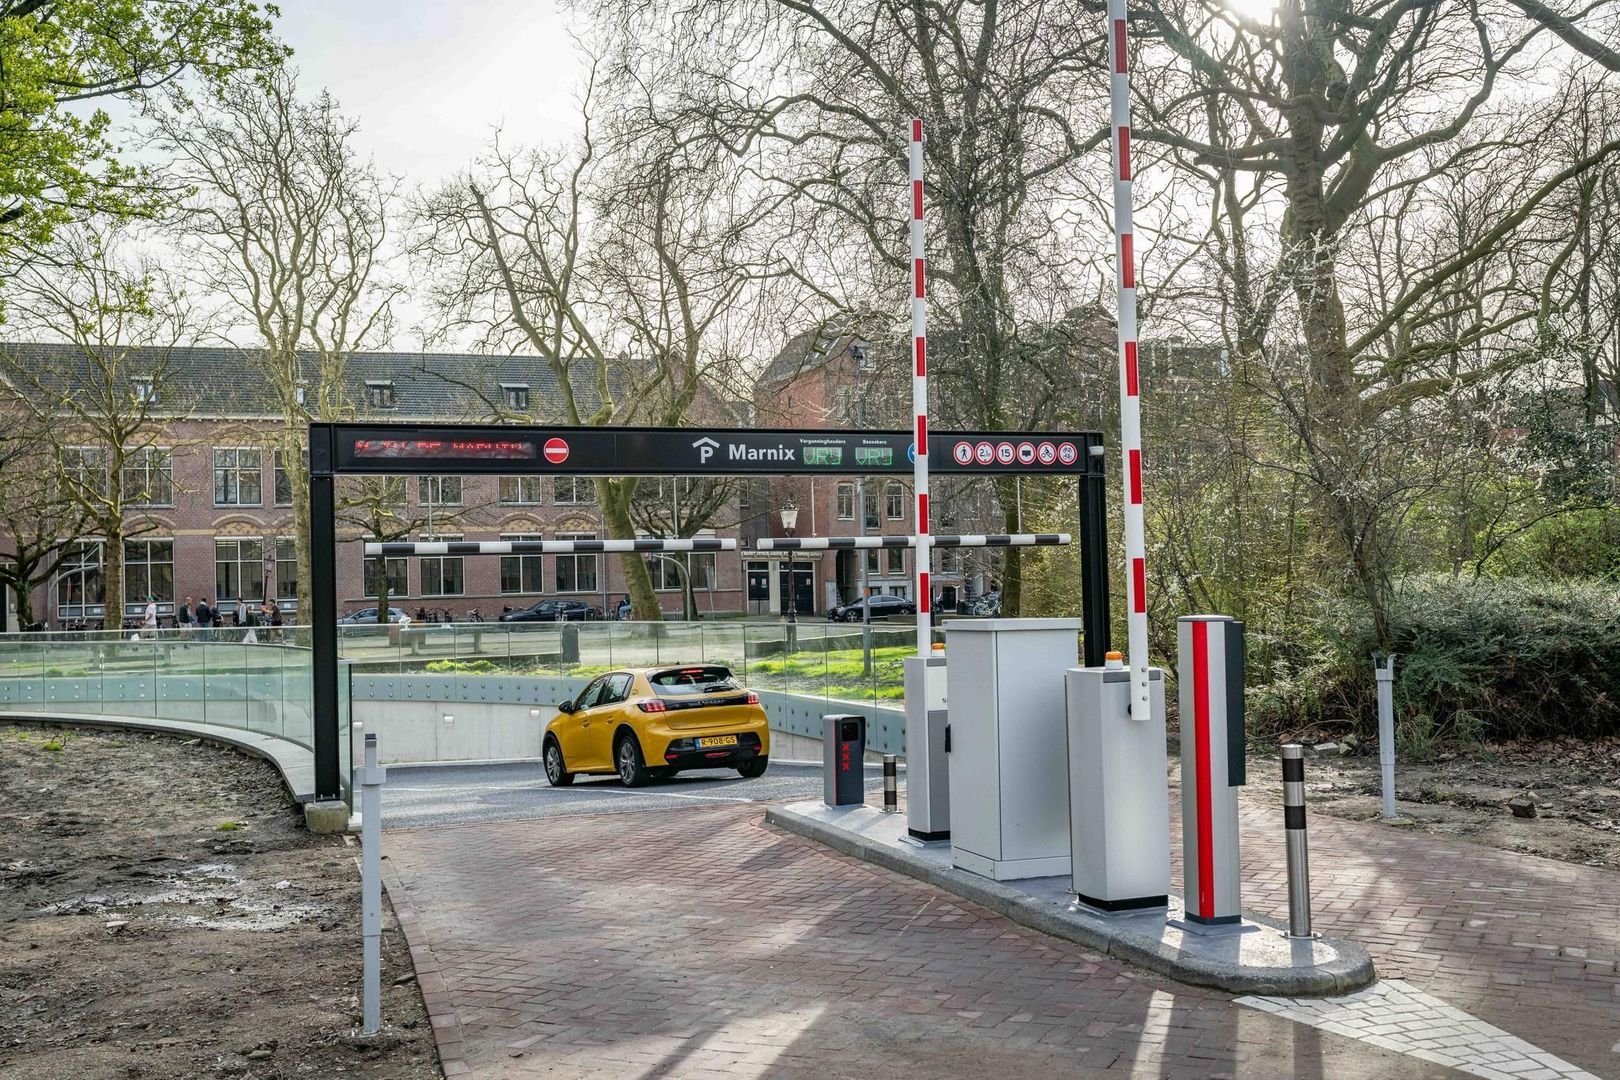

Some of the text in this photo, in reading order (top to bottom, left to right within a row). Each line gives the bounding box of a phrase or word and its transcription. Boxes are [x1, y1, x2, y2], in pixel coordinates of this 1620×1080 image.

[728, 443, 796, 461] Marnix
[1000, 448, 1011, 458] 15
[701, 736, 736, 746] R-908-GS
